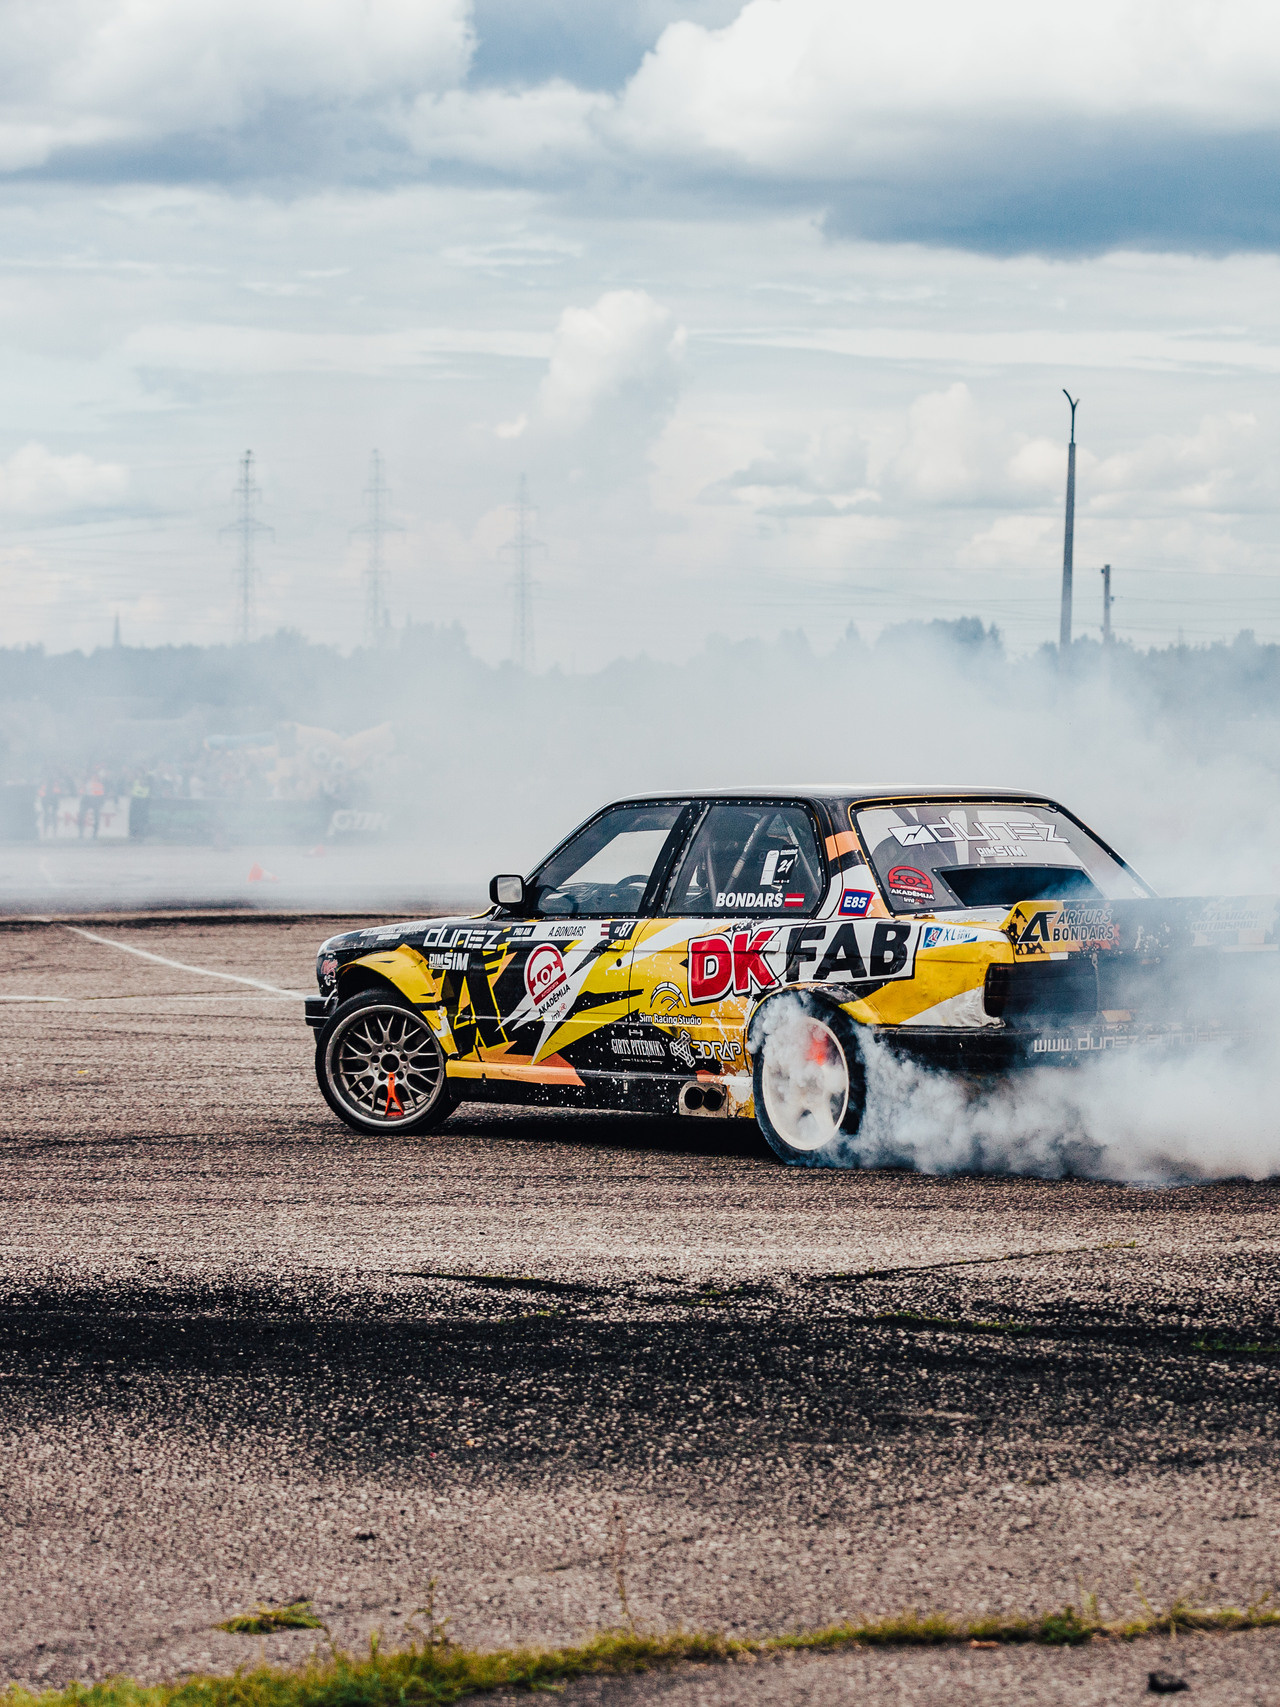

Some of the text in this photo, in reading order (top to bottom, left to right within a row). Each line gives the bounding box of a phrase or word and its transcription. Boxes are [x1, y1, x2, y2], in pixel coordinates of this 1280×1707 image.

[715, 892, 783, 908] BONDARS
[842, 896, 868, 910] E85
[1057, 909, 1113, 925] ARTURS
[620, 922, 633, 937] 87
[1052, 924, 1114, 942] BONDARS
[640, 1013, 702, 1025] Sim Racing Studio
